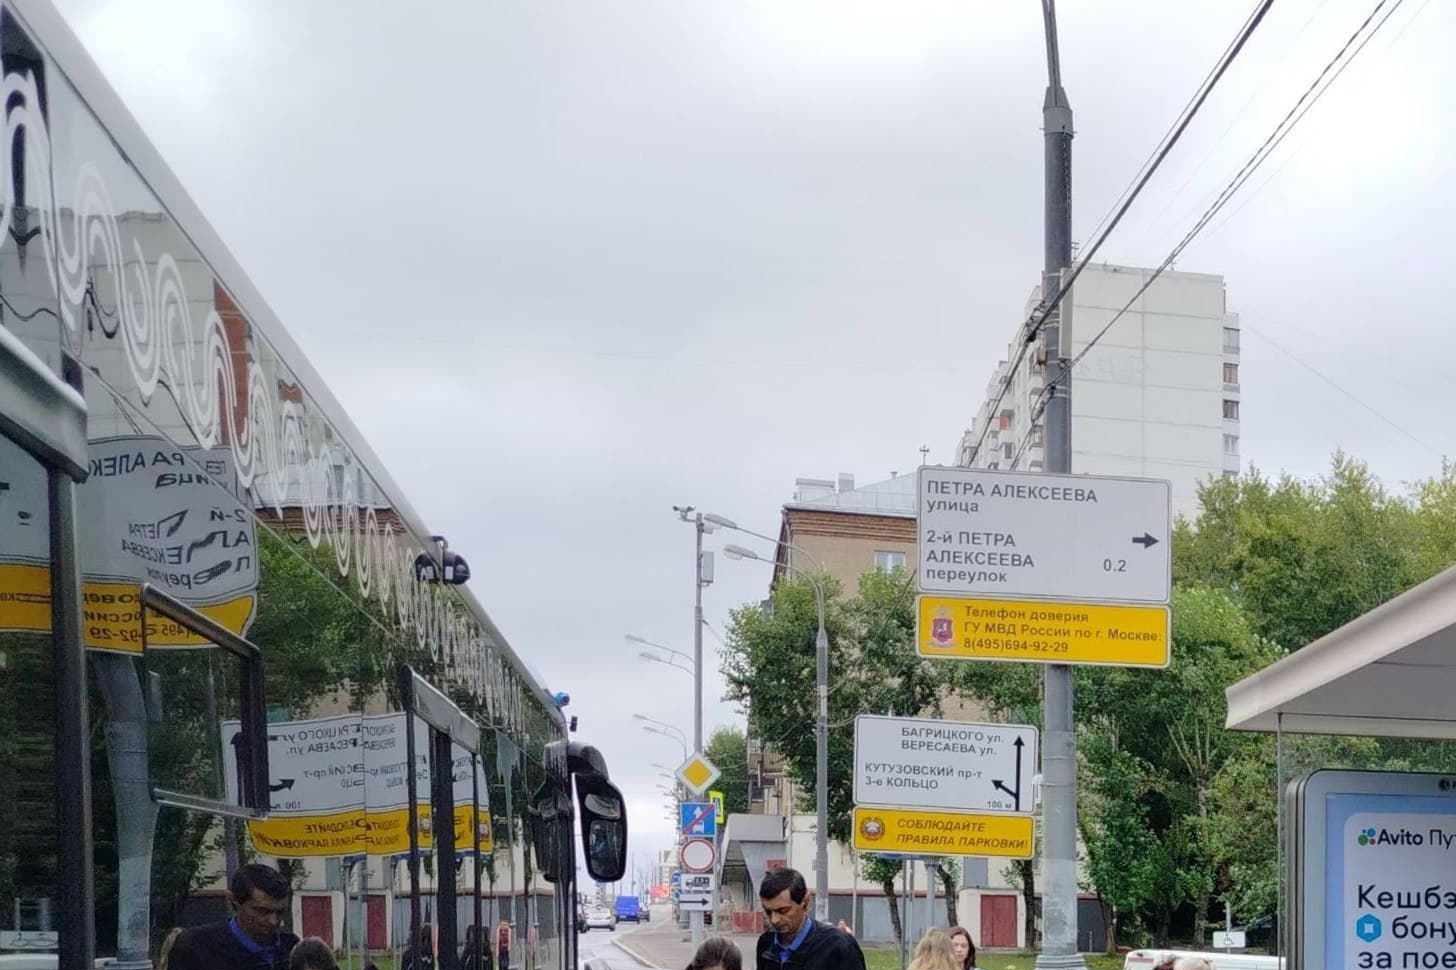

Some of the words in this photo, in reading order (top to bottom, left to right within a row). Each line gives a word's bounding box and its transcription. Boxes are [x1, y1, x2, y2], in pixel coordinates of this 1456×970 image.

[927, 480, 985, 496] ПЕТРА
[991, 484, 1098, 502] АЛЕКСЕЕВА
[927, 499, 979, 513] улица
[926, 530, 952, 544] 2-й
[959, 532, 1016, 547] ПЕТРА
[926, 550, 1034, 567] АЛЕКСЕЕВА
[1103, 559, 1127, 573] 0.2
[926, 568, 1007, 584] переулок
[964, 606, 1026, 620] Телефон
[1030, 608, 1089, 623] доверия
[964, 621, 980, 634] ГУ
[985, 623, 1016, 636] МВД
[1021, 625, 1071, 638] России
[1075, 628, 1091, 639] по
[964, 638, 1069, 653] 8(495)694-92-29
[901, 727, 984, 742] БАГРИЦКОГО
[986, 734, 1005, 745] ул.
[901, 740, 977, 754] ВЕРЕСАЕВА
[979, 746, 997, 757] ул.
[865, 762, 954, 777] КУТУЗОВСКИЙ
[957, 769, 982, 780] пр-т
[865, 776, 883, 787] 3-е
[886, 777, 939, 790] КОЛЬЦО
[987, 801, 1003, 809] 100
[897, 818, 987, 833] СОБЛЮДАЙТЕ
[896, 833, 954, 846] ПРАВИЛА
[958, 836, 1028, 849] ПАРКОВКИ!
[1377, 829, 1423, 846] Avito
[1358, 951, 1392, 969] за
